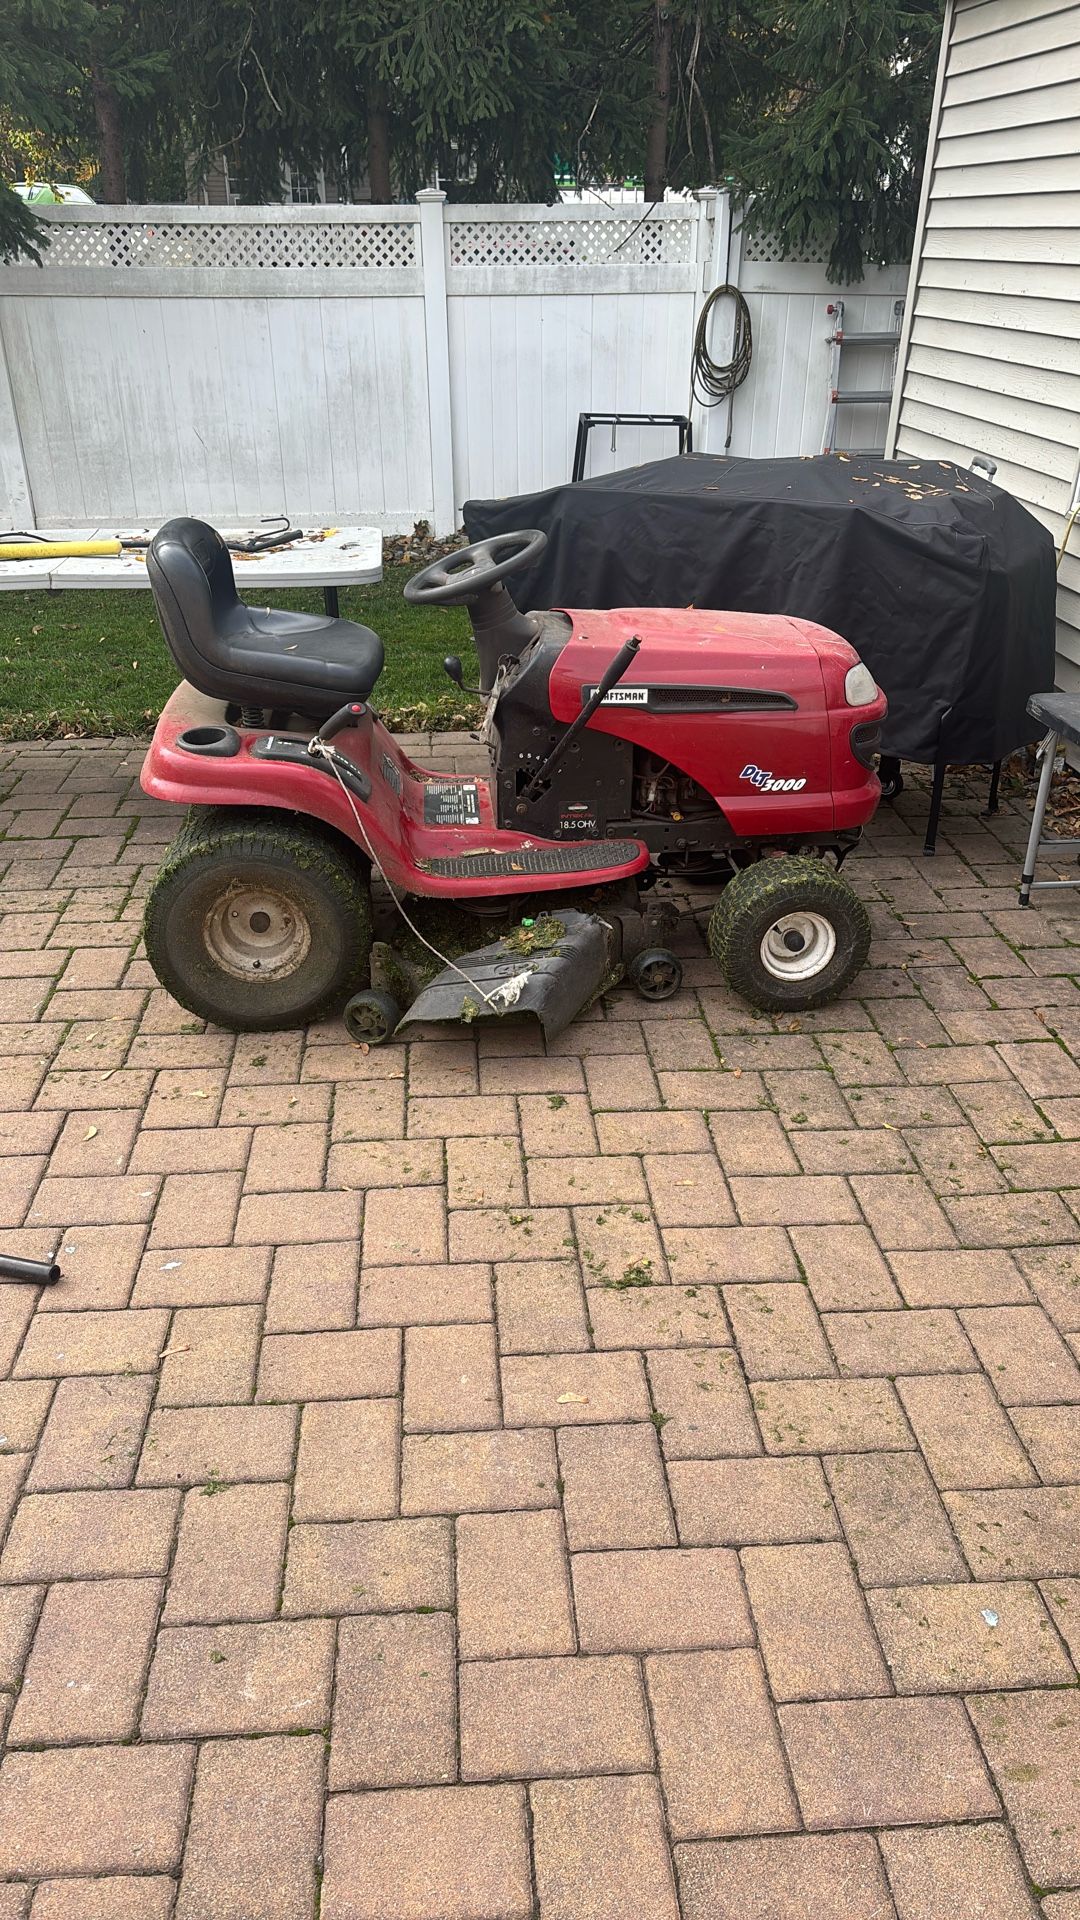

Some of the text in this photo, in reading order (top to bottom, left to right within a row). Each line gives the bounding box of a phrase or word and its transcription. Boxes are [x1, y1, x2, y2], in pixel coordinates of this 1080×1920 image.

[602, 692, 644, 701] AFTSMAN
[739, 764, 807, 792] DLT 3000
[560, 820, 596, 829] 18.5 OHV
